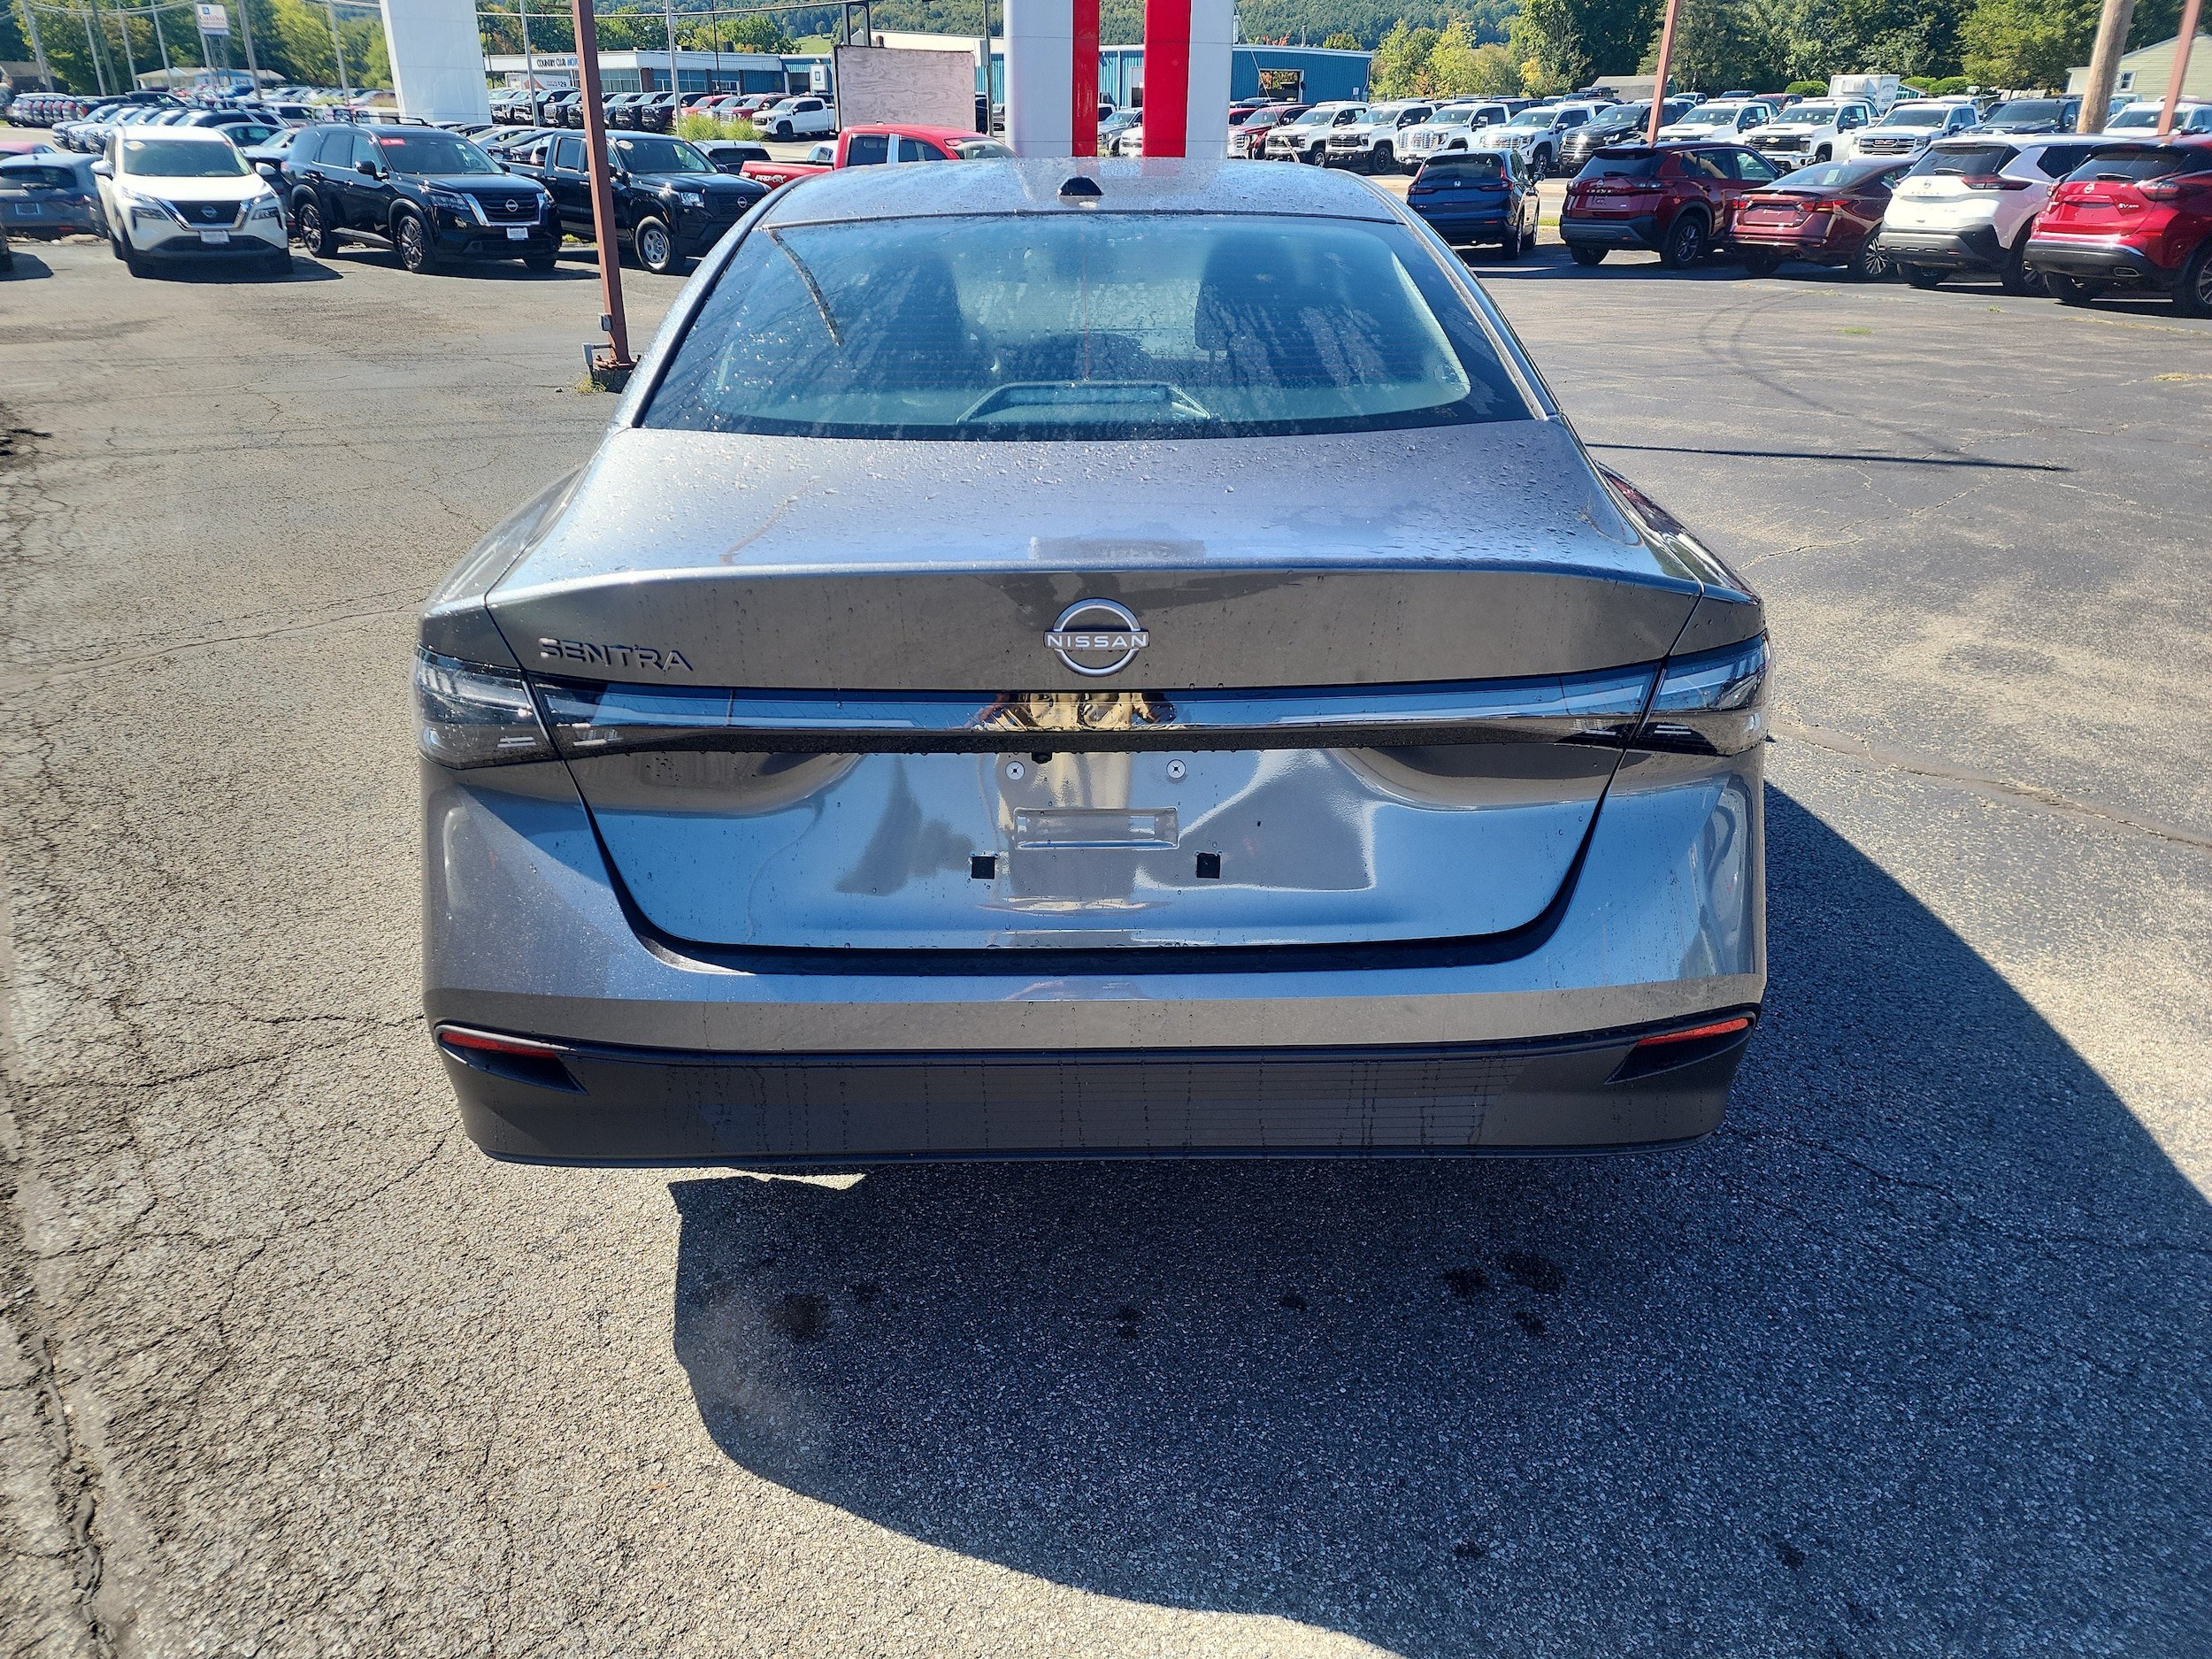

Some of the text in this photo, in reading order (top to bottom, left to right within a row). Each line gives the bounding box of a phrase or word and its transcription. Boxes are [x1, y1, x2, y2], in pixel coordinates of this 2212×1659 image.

[537, 58, 556, 68] COUNTRY
[556, 58, 566, 67] CLUB
[1047, 634, 1147, 648] NISSAN
[538, 637, 695, 672] SENTRA
